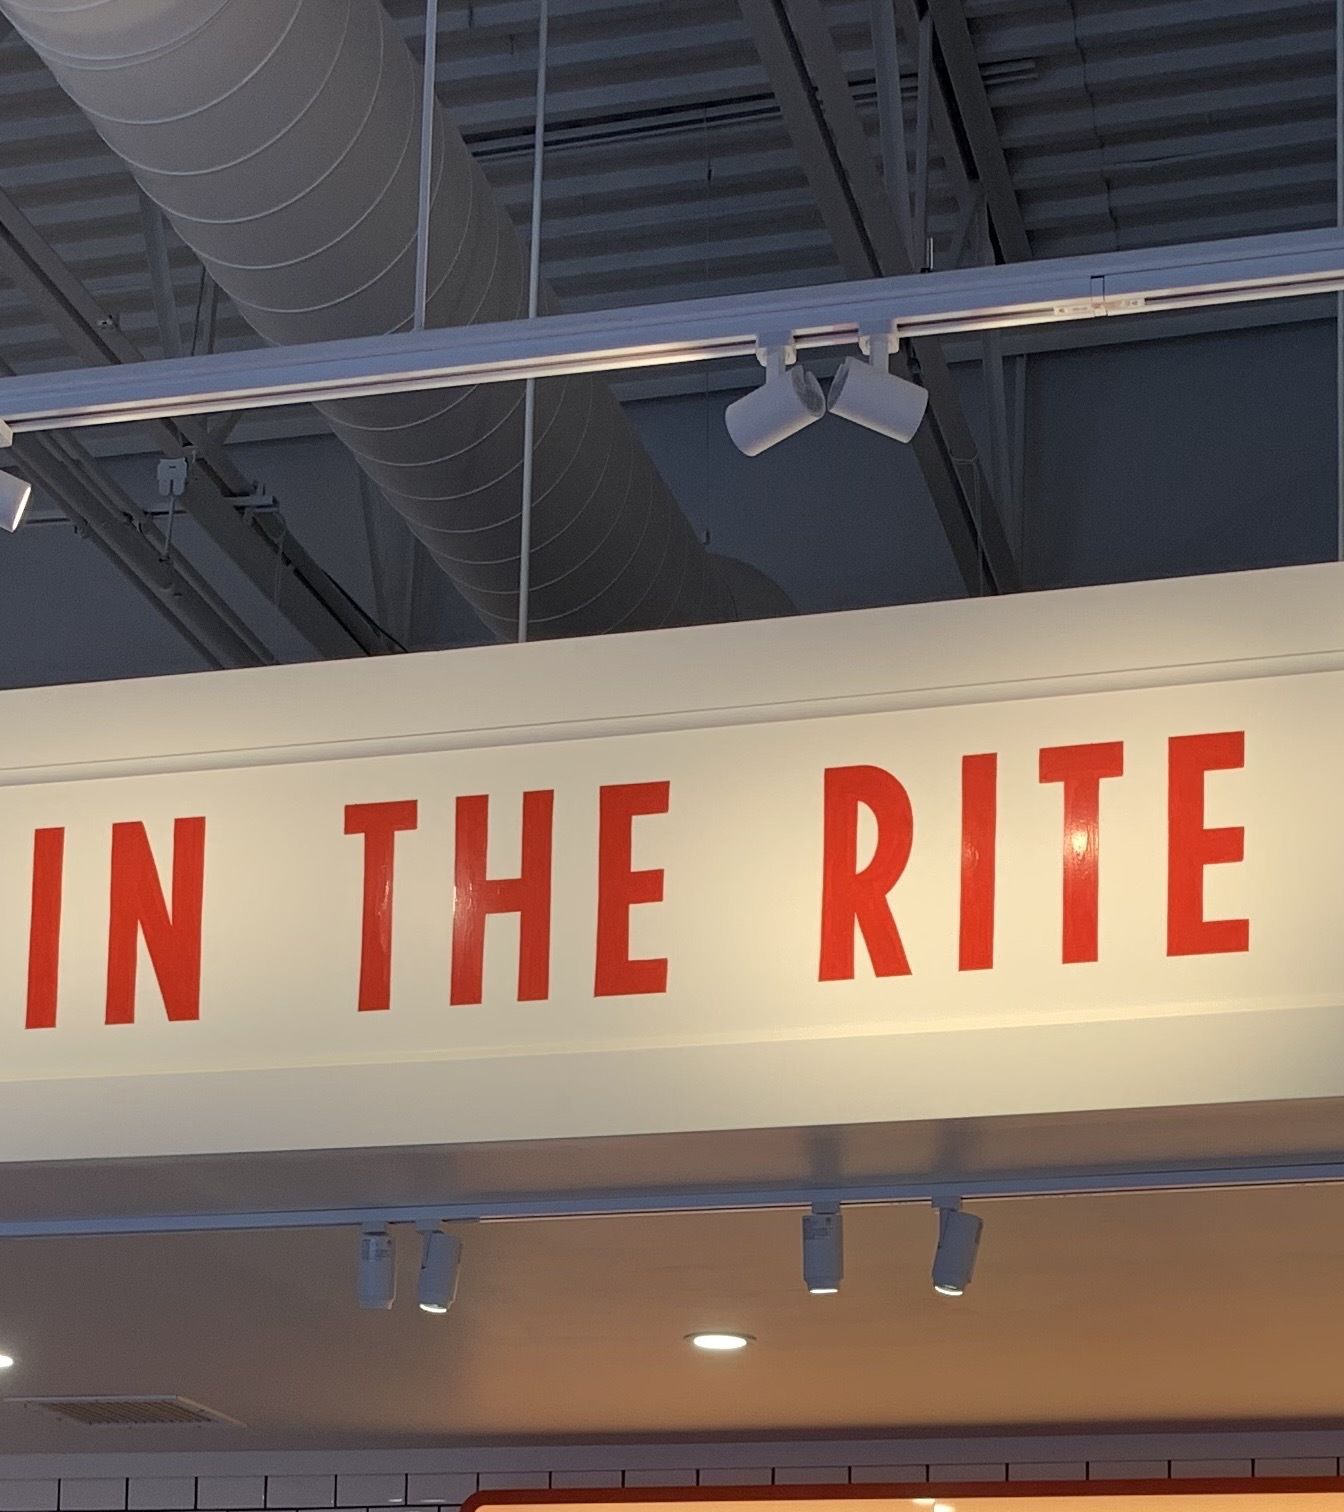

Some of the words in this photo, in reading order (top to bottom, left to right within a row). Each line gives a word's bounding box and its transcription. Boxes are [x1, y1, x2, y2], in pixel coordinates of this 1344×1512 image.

[25, 816, 205, 1029] IN
[344, 781, 671, 1011] THE
[819, 730, 1250, 983] RITE
